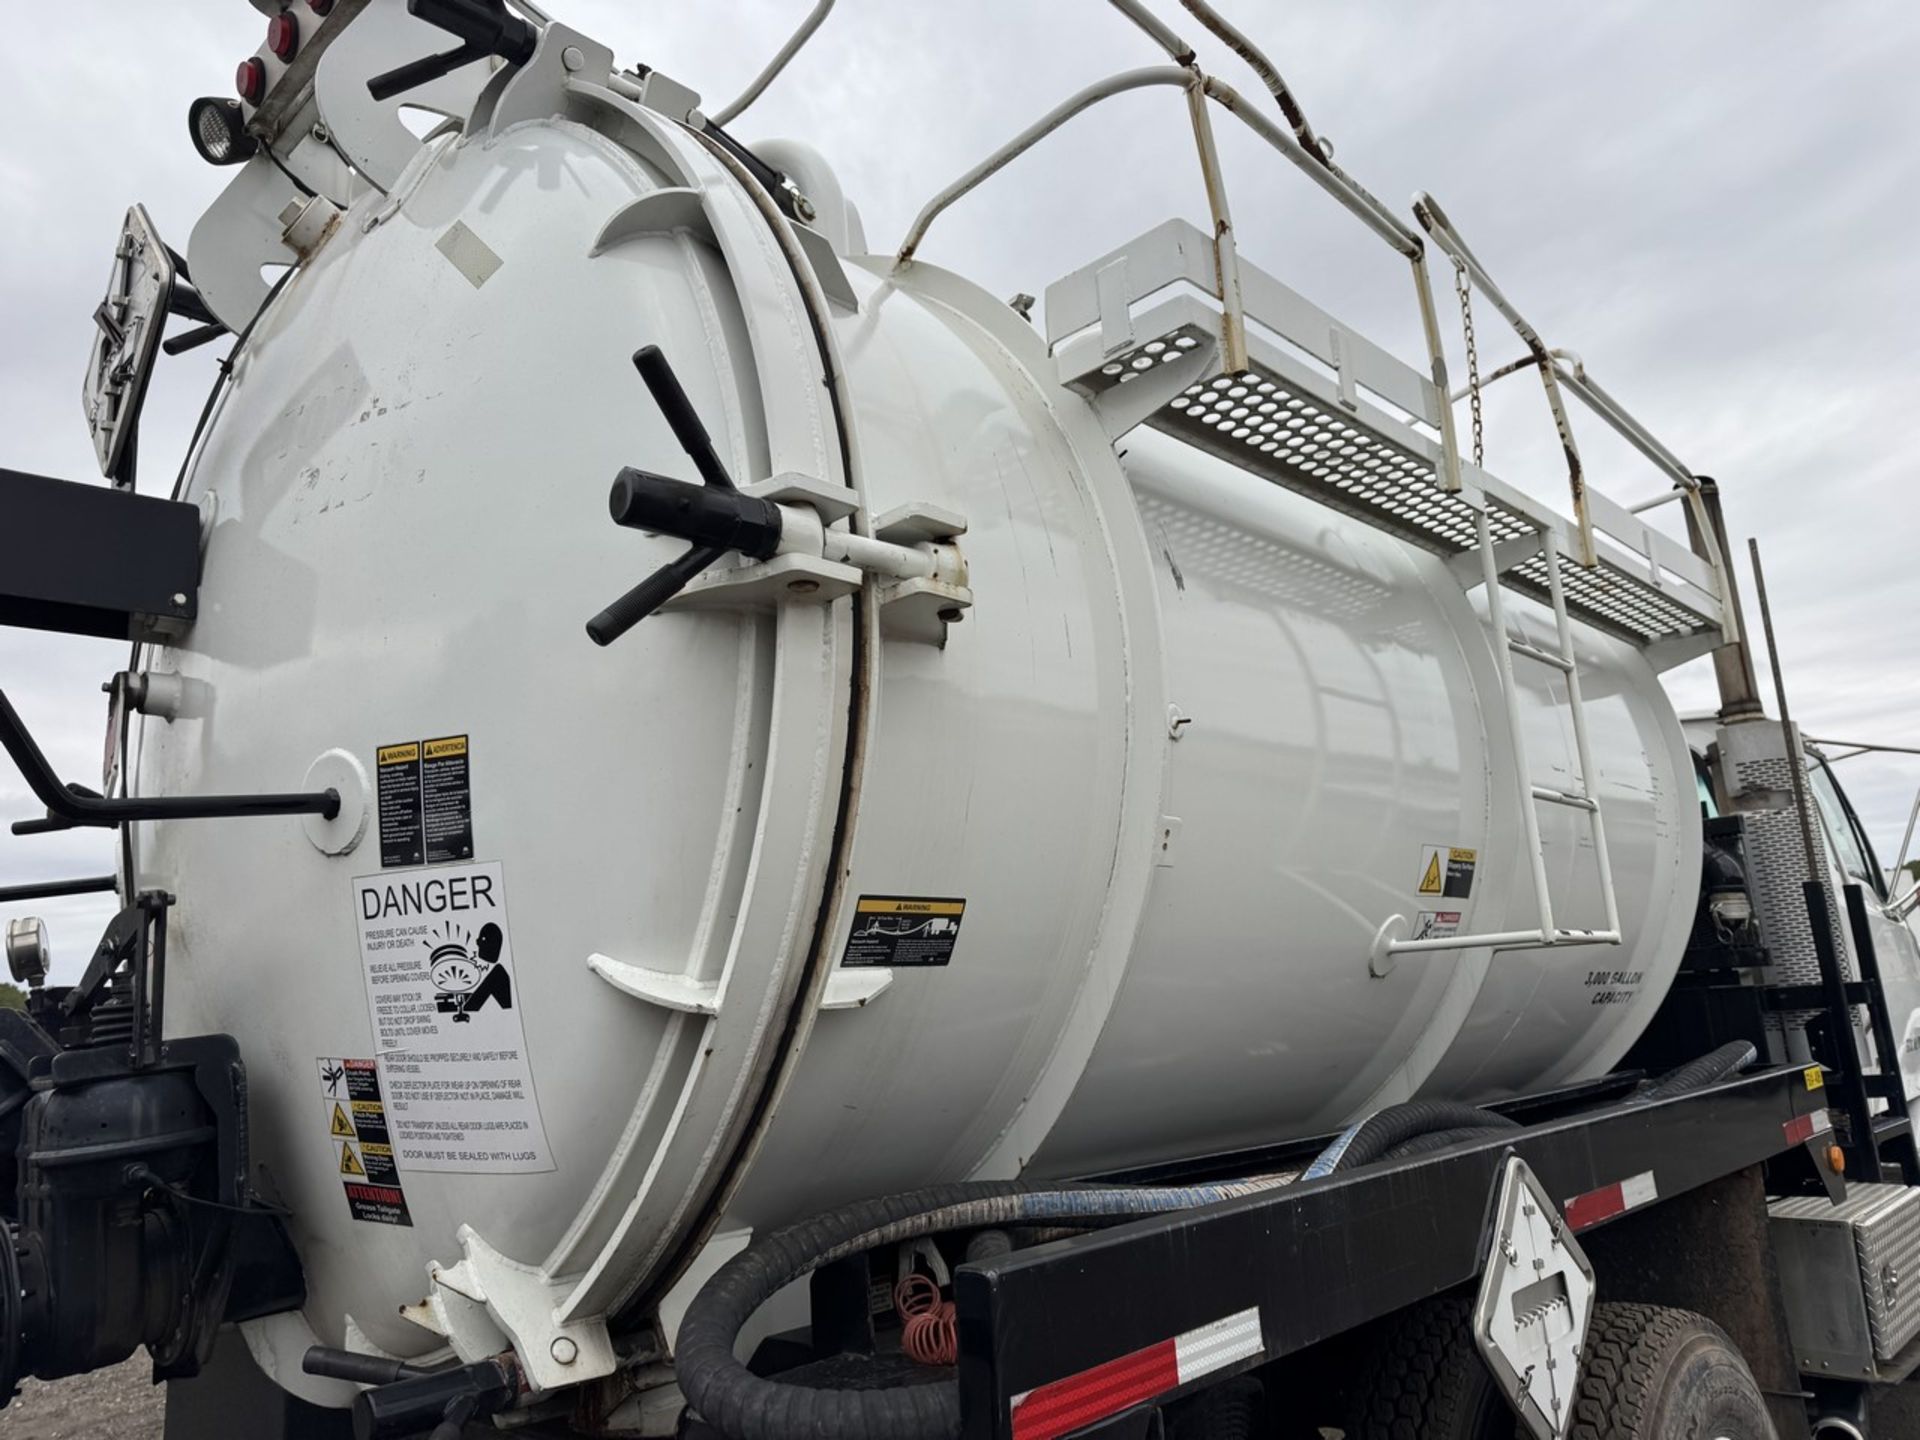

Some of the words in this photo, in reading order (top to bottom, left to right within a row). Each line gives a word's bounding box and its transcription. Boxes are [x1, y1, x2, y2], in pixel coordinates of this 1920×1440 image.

[387, 748, 416, 760] WARNING
[361, 875, 496, 920] DANGER
[365, 929, 394, 939] PRESSURE
[395, 927, 407, 937] CAN
[407, 925, 428, 935] CAUSE
[366, 940, 386, 951] INJURY
[386, 939, 395, 949] OR
[395, 938, 415, 948] DEATH
[1585, 971, 1611, 988] 3,000
[1610, 971, 1643, 985] GALLON
[1591, 990, 1633, 1005] CAPACITY
[357, 1103, 383, 1111] CAUTION
[366, 1145, 392, 1153] CAUTION
[403, 1150, 424, 1159] DOOR
[424, 1150, 445, 1159] MUST
[446, 1151, 458, 1159] BE
[458, 1151, 489, 1160] SEALED
[489, 1151, 511, 1160] WITH
[512, 1151, 537, 1160] LUGS
[355, 1202, 377, 1211] Grease
[376, 1204, 401, 1215] Tailgate
